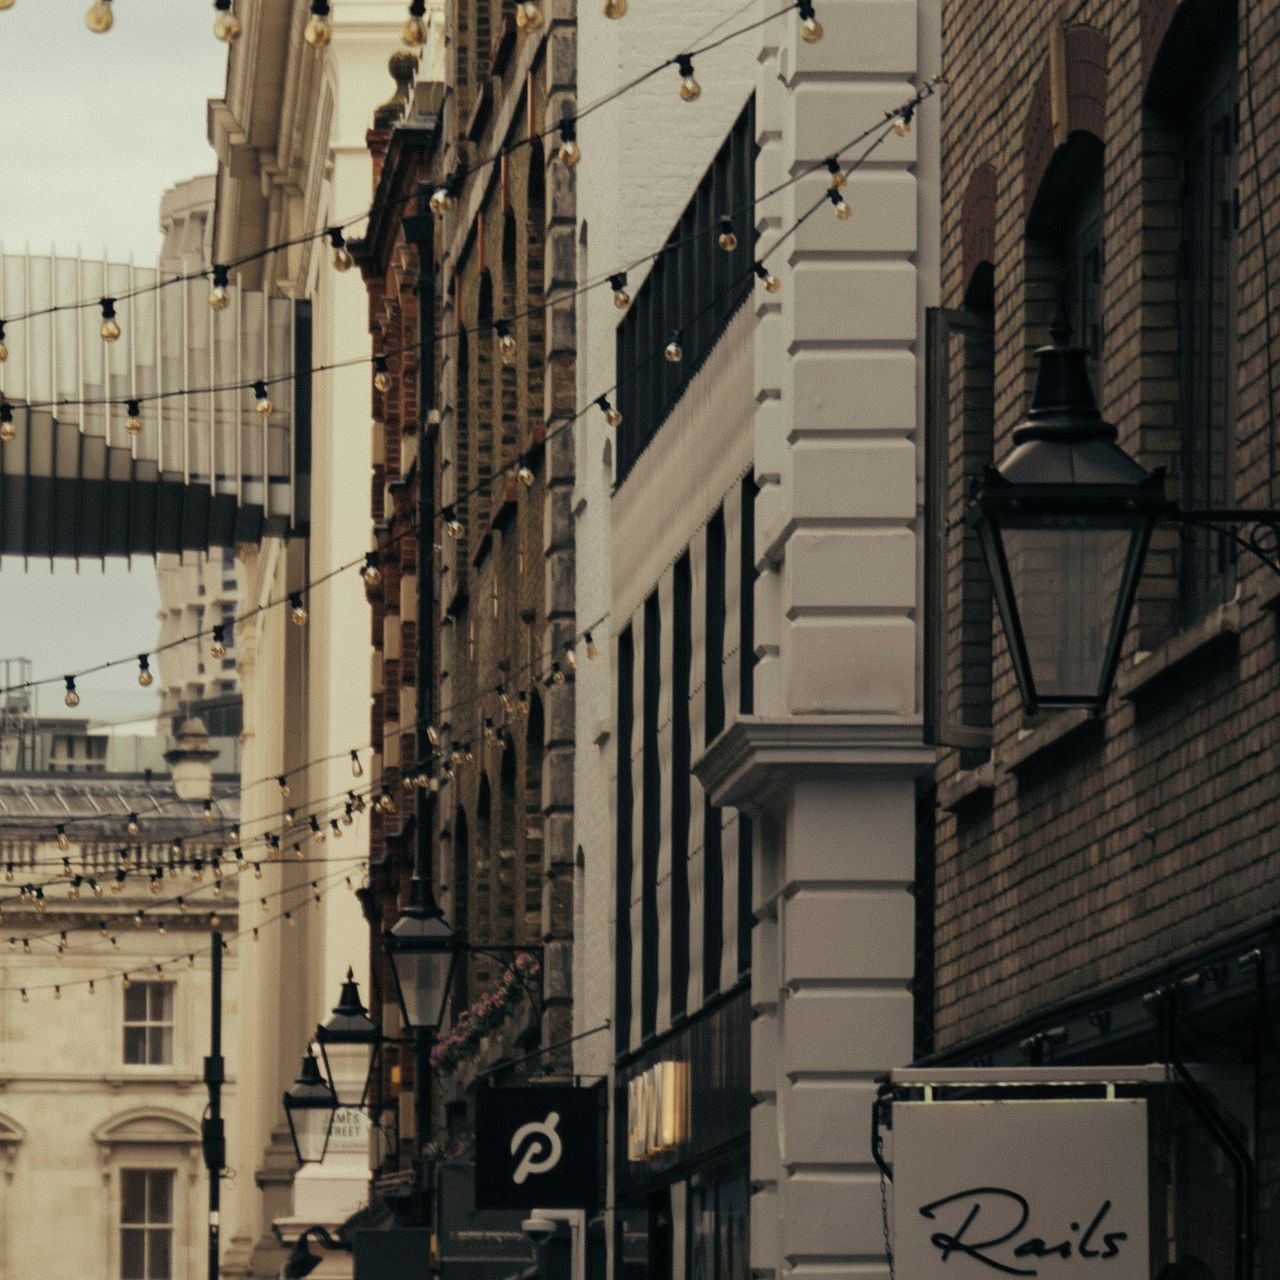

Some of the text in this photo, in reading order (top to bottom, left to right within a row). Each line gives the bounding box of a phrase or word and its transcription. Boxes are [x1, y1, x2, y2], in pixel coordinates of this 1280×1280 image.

[324, 1111, 360, 1124] JMES
[321, 1125, 360, 1136] SREET
[919, 1186, 1128, 1277] Rails
